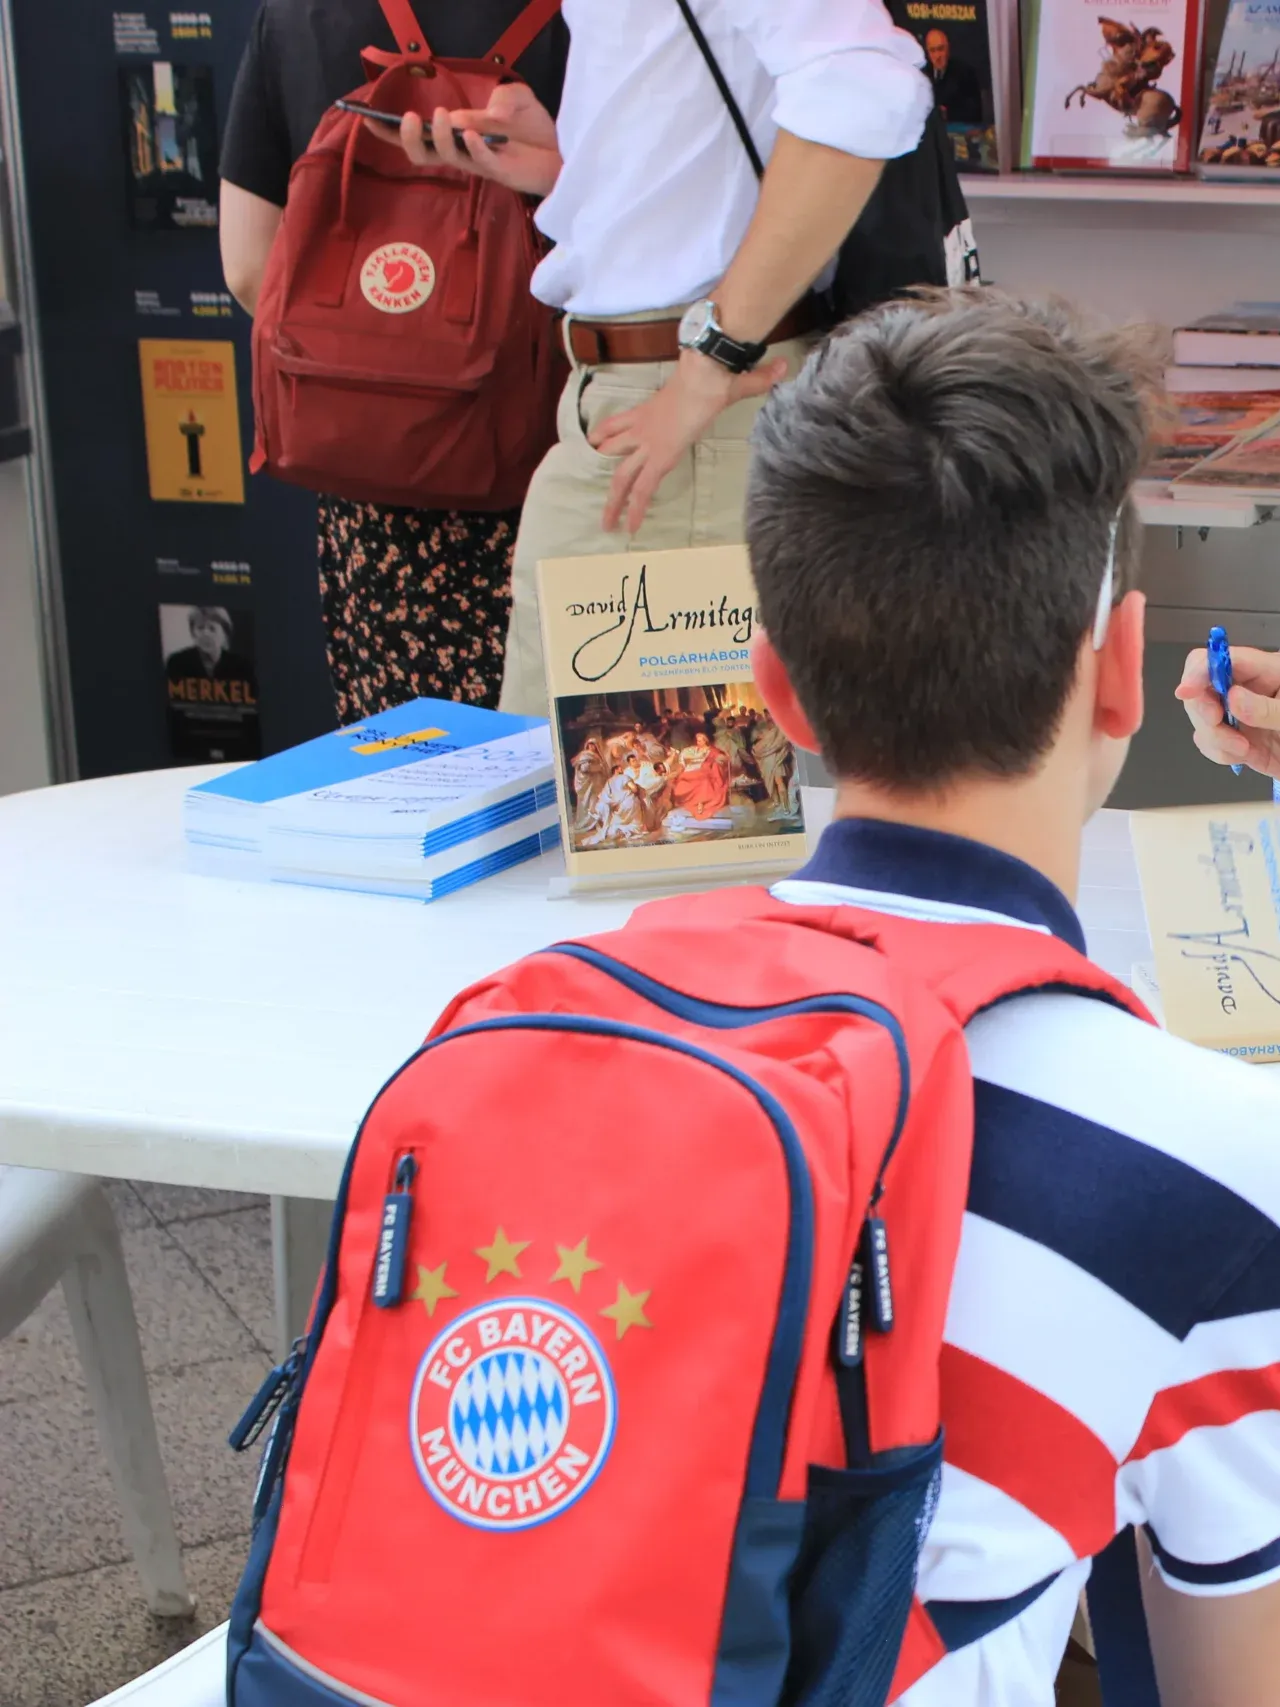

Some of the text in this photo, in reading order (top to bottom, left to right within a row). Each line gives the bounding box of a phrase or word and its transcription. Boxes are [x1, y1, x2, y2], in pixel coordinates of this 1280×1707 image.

[168, 677, 257, 704] MERKEL
[639, 649, 750, 667] POLGÁRHÁBOR
[720, 662, 753, 672] TÖRTÉN
[375, 1204, 398, 1297] FC BAYERN
[875, 1228, 893, 1321] FC BAYERN
[428, 1312, 602, 1407] FC BAYERN
[846, 1288, 861, 1356] BAYERN
[421, 1426, 591, 1517] MÜNCHEN
